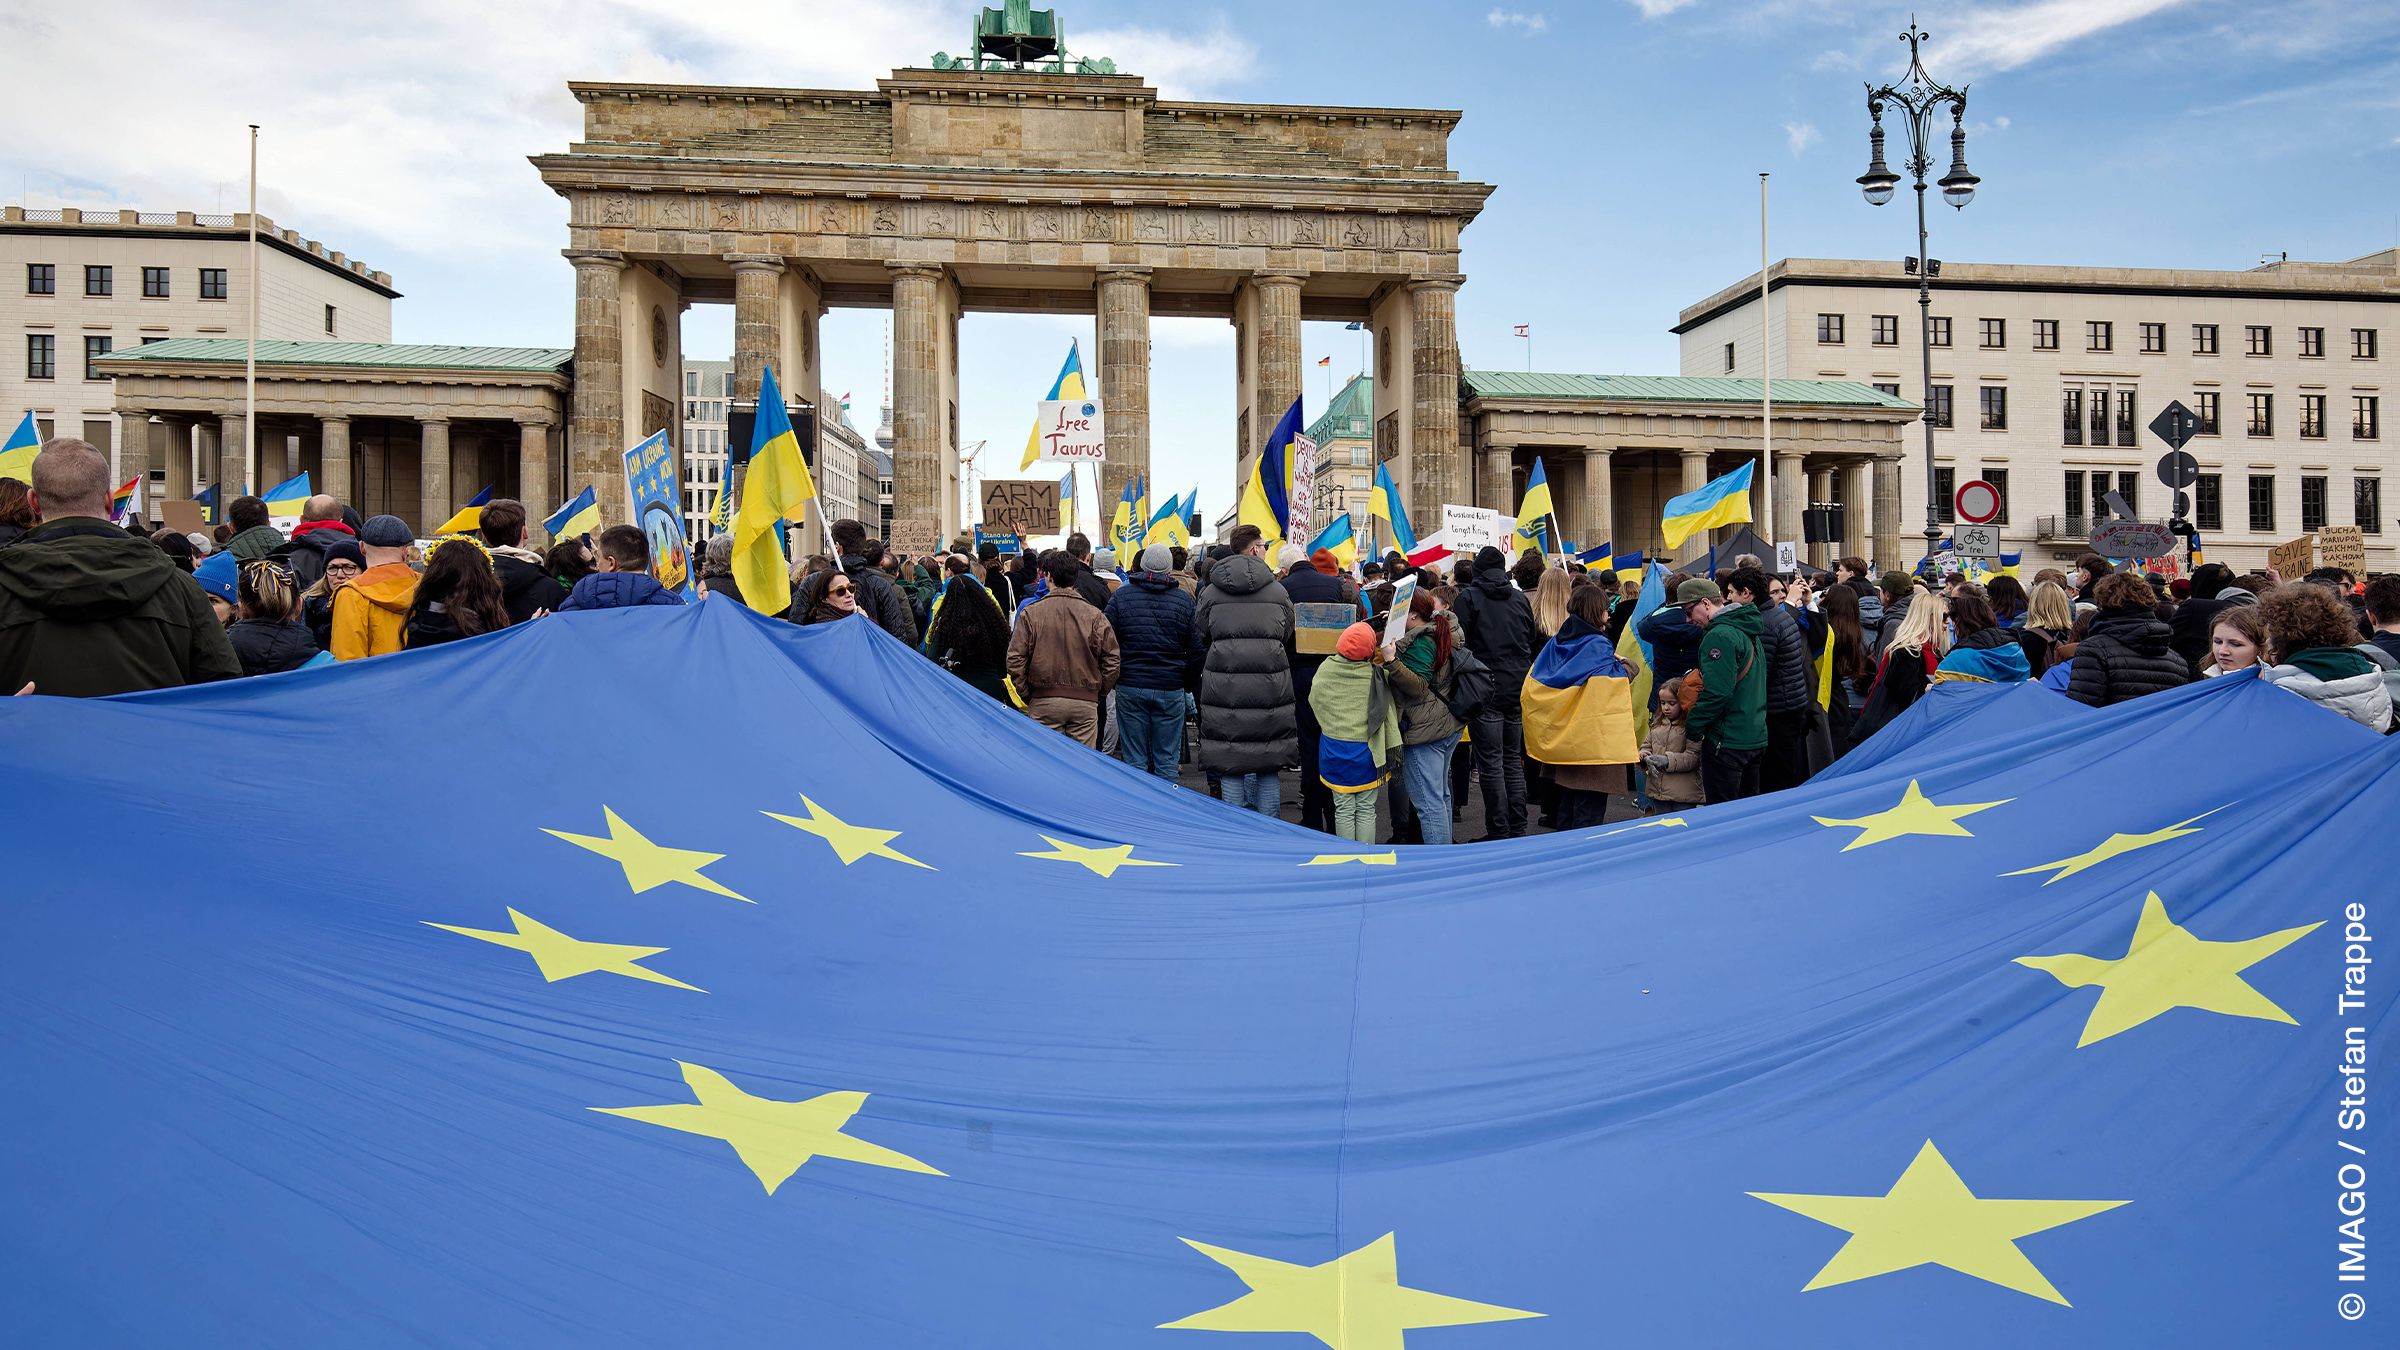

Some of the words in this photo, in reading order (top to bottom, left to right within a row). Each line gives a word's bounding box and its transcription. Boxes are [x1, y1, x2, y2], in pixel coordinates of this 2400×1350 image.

[1045, 433, 1103, 457] Taurus
[629, 453, 643, 480] ARM
[987, 483, 1052, 507] ARM
[983, 505, 1059, 529] UKRAINE
[1969, 546, 1984, 554] frei
[2274, 539, 2307, 565] SAVE
[2322, 543, 2363, 553] BAKHMUT
[2273, 556, 2311, 580] KRAINE
